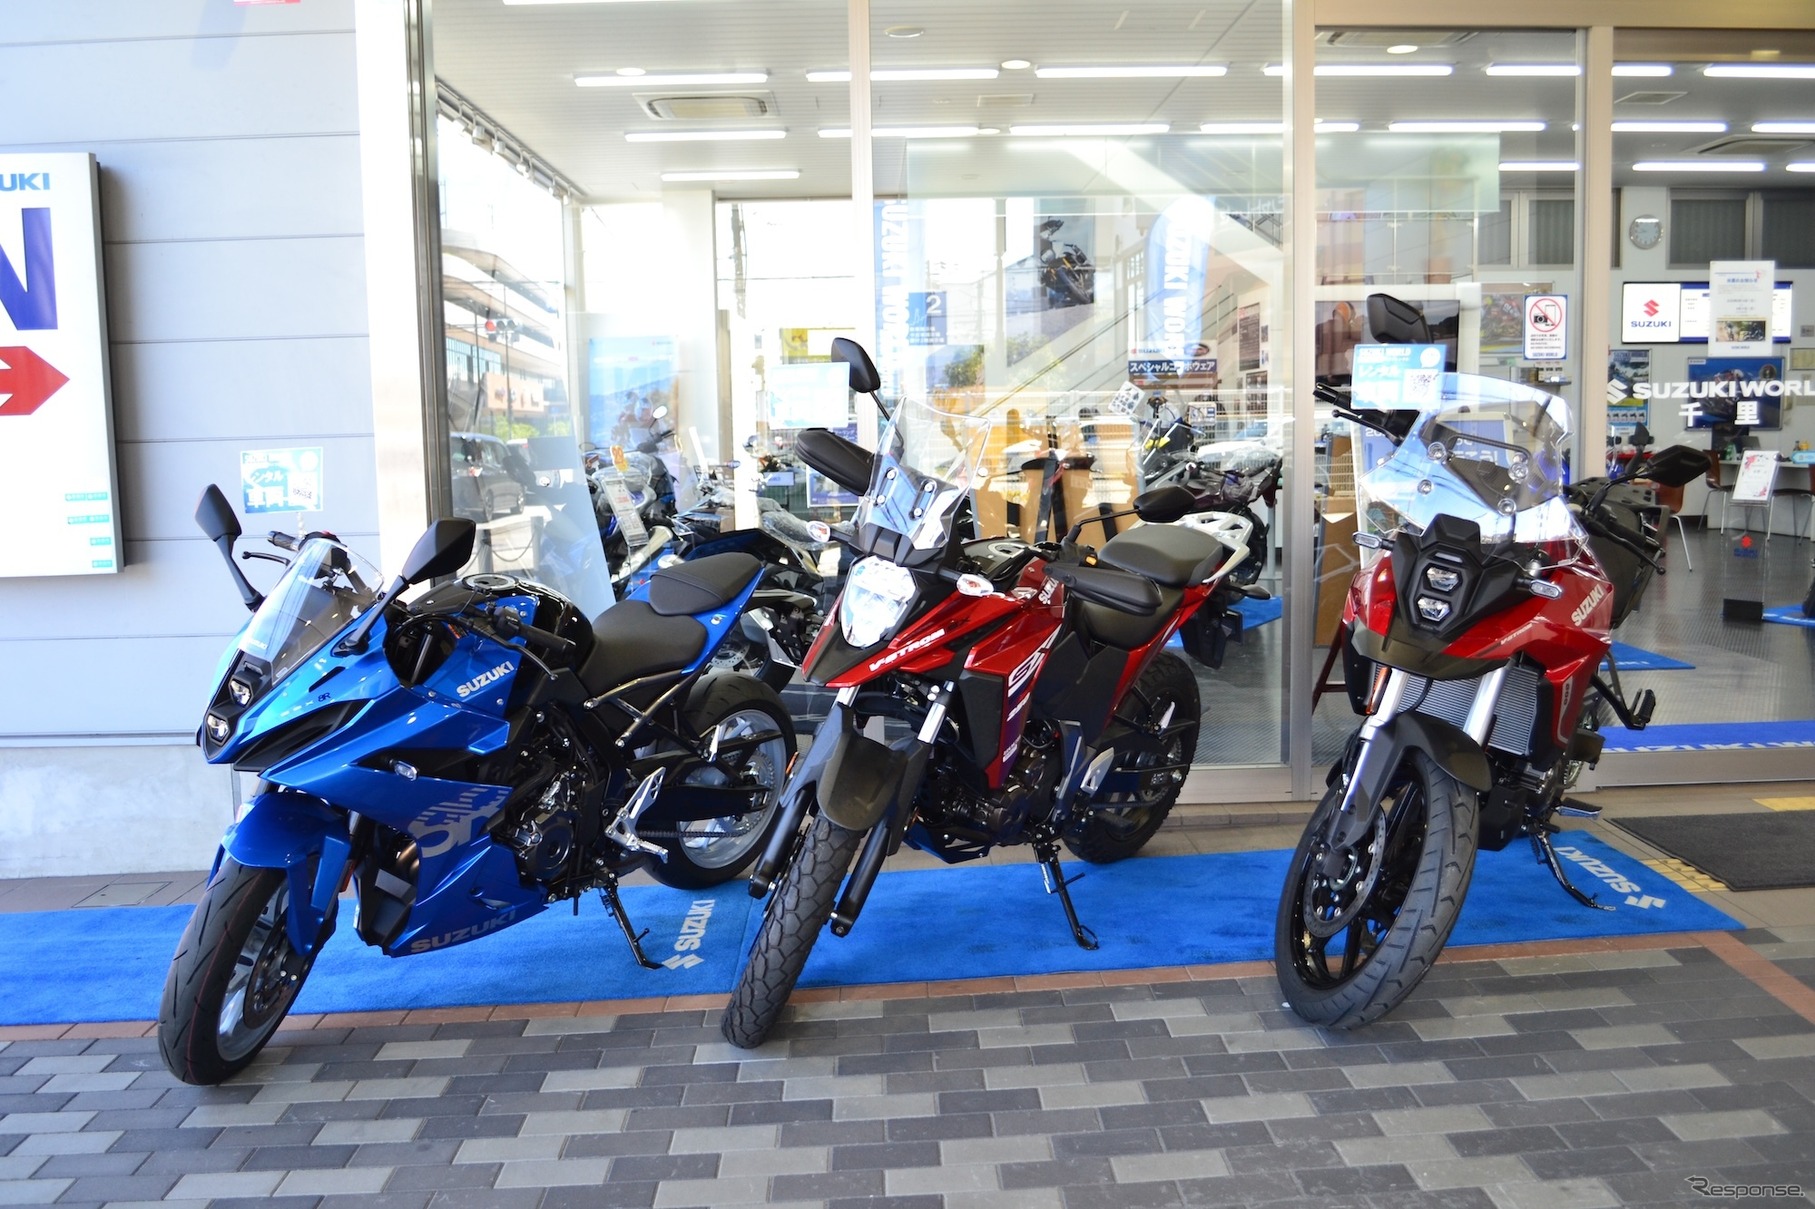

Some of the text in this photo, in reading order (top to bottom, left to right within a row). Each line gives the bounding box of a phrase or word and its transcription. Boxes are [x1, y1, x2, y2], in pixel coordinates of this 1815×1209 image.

[1632, 380, 1736, 399] SUZUKI
[1571, 584, 1604, 626] SUZUKI
[868, 628, 945, 672] V-STROM
[456, 660, 514, 698] SUZUKI
[1553, 846, 1642, 894] SUZUKI
[410, 909, 517, 953] SUZUKI
[673, 899, 716, 952] SUZUKI
